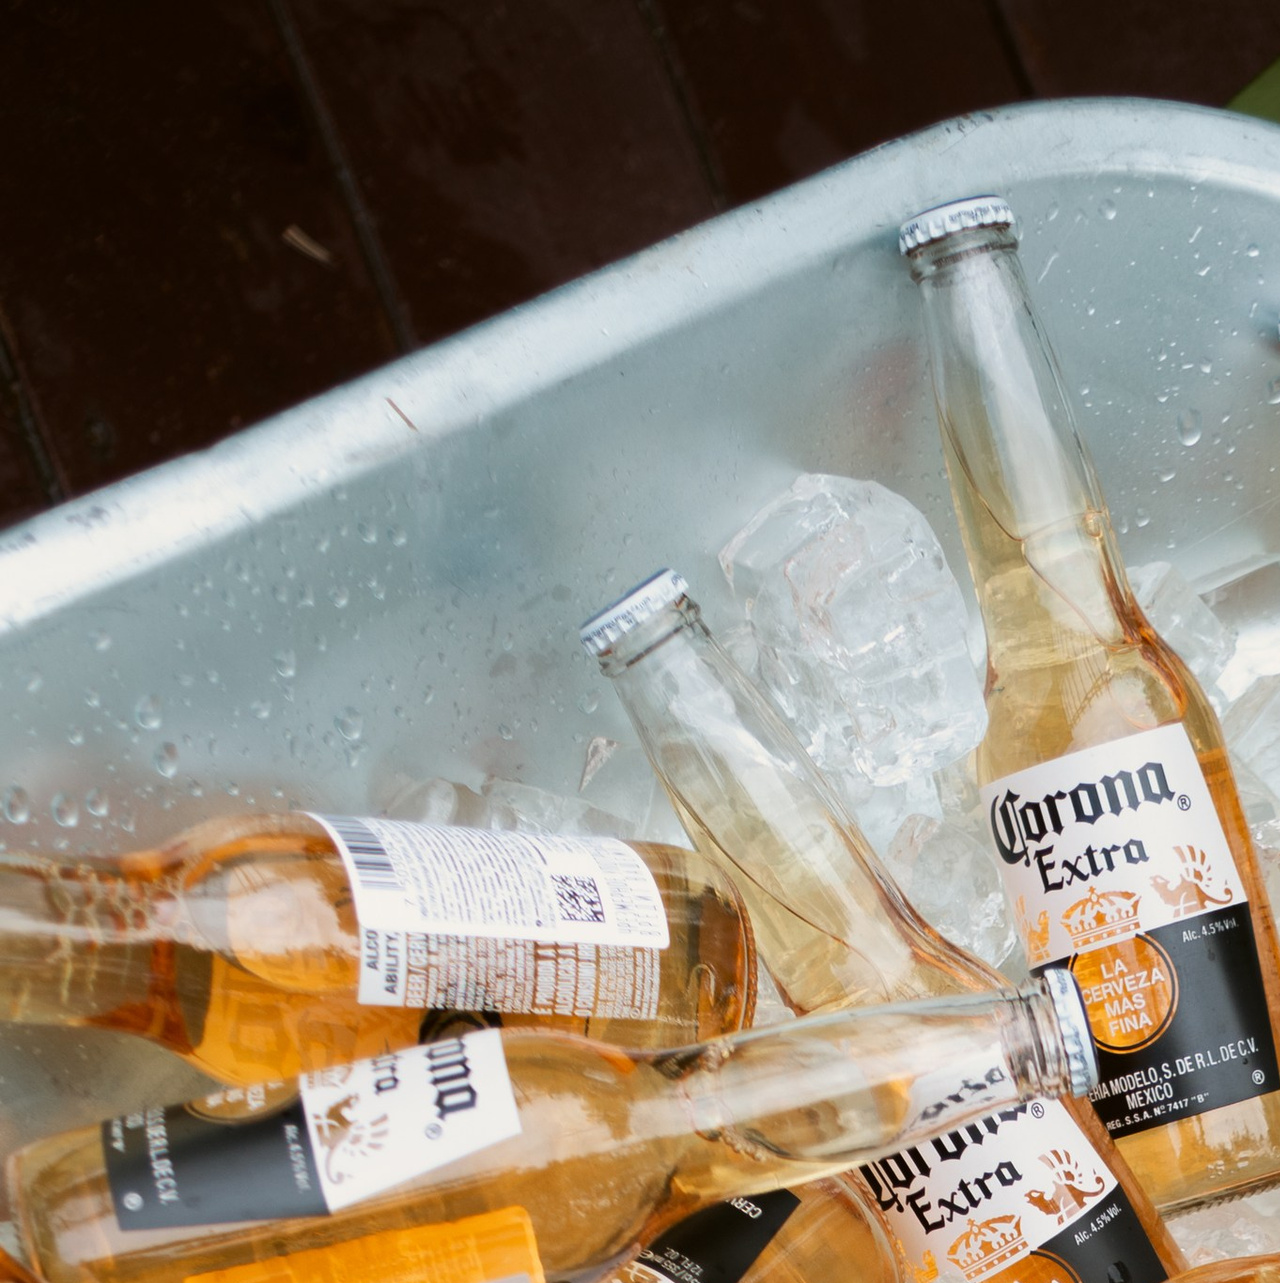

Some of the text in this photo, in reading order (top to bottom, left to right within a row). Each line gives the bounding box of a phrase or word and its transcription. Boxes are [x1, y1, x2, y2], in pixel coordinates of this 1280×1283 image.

[991, 763, 1175, 867] Corona
[1034, 840, 1148, 894] Extra
[1081, 967, 1166, 1005] CERVEZA
[1101, 959, 1128, 979] LA
[1104, 988, 1146, 1018] MAS
[1109, 1012, 1152, 1037] FINA
[1108, 1066, 1163, 1096] MODELO,
[1161, 1062, 1177, 1080] S.
[1175, 1055, 1195, 1076] DE
[1194, 1050, 1221, 1070] R.L.
[1219, 1042, 1238, 1062] DE
[1236, 1037, 1256, 1057] C.V.
[1125, 1082, 1174, 1110] MEXICO
[1166, 1098, 1189, 1112] 7417
[906, 1162, 1022, 1234] Extra
[1074, 1212, 1112, 1246] Alc. 4.5%
